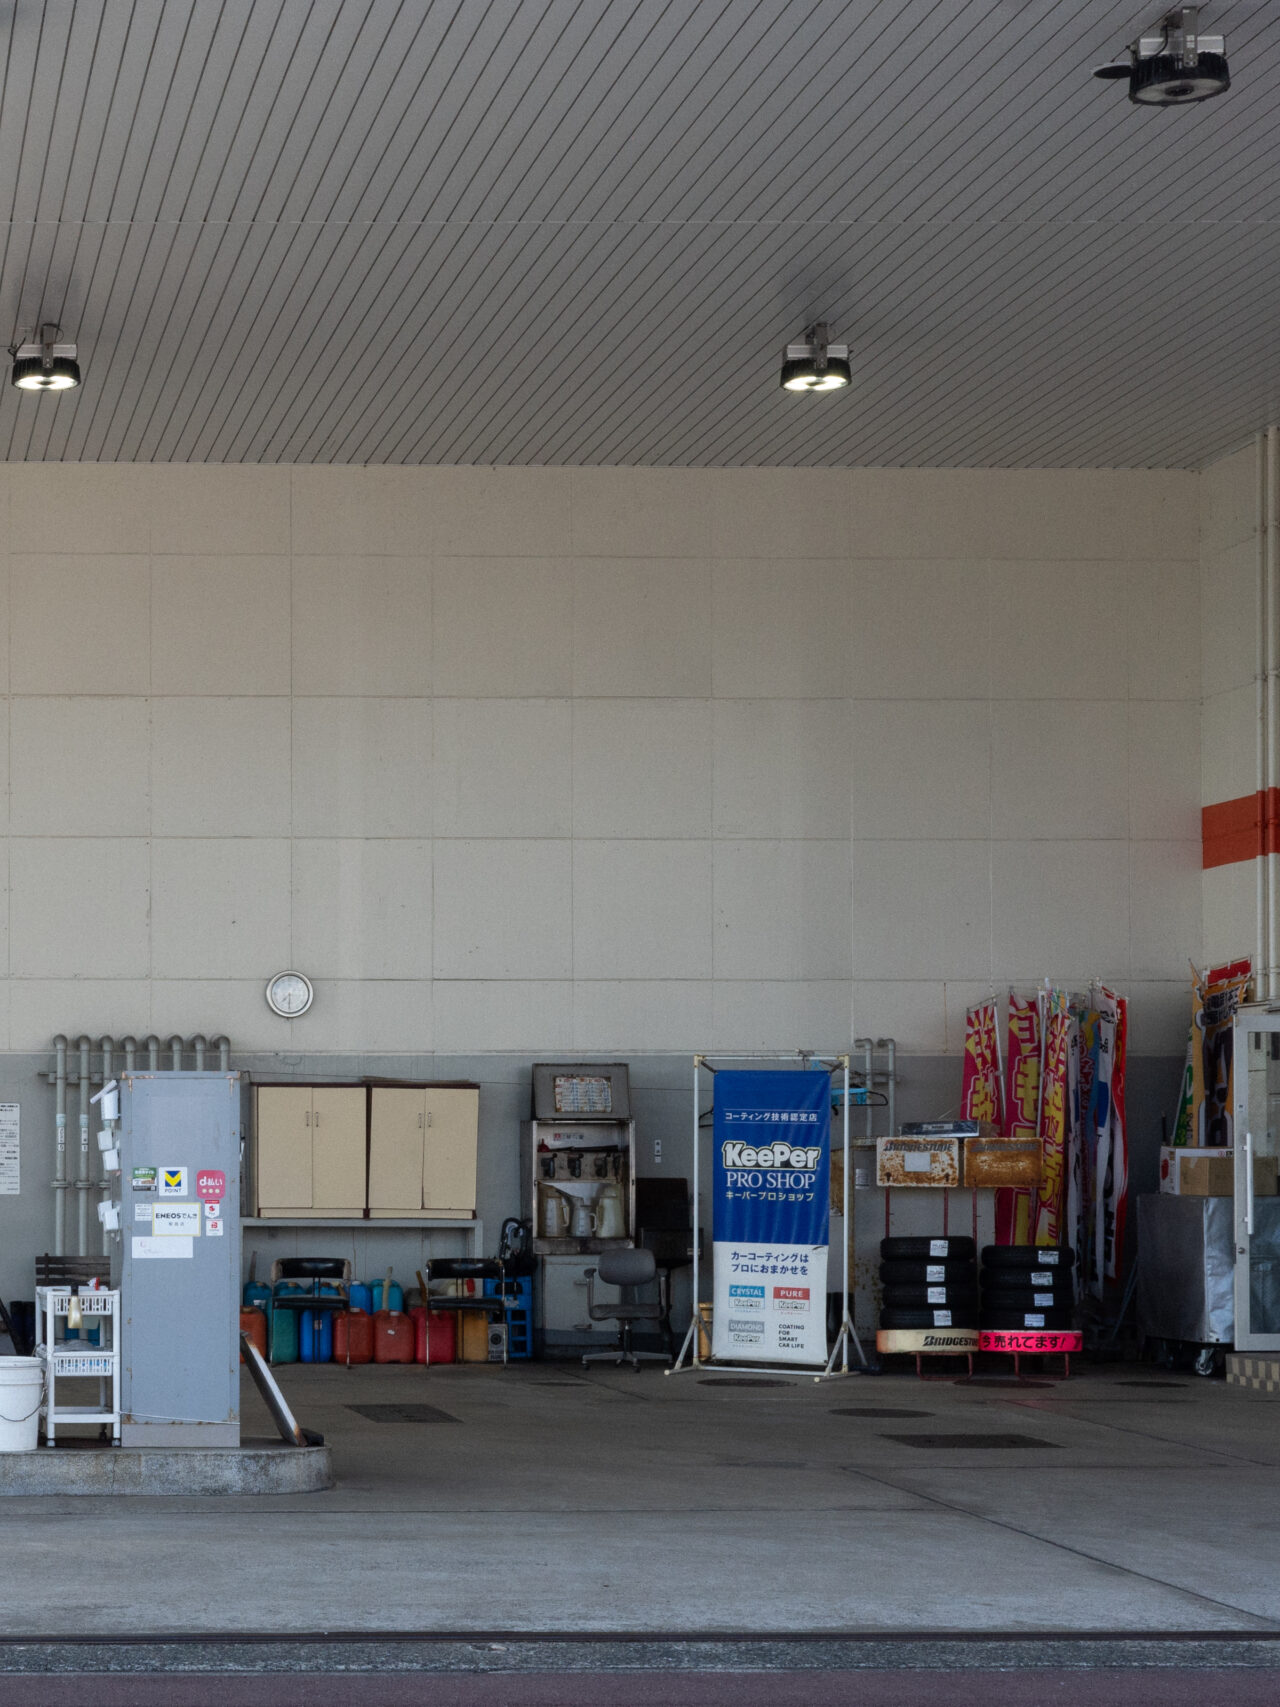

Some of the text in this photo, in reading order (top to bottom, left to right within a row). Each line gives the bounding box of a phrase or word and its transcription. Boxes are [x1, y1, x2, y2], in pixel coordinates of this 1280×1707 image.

[725, 1112, 818, 1122] コーティング技術認定店
[723, 1141, 821, 1169] KeePer
[726, 1172, 816, 1189] PRO SHOP
[725, 1191, 814, 1202] キーパープロショップ
[731, 1251, 809, 1263] カーコーティングは
[731, 1263, 809, 1275] プロにおまかせを
[731, 1288, 763, 1297] CRYSTAL
[780, 1290, 804, 1298] PURE
[730, 1322, 763, 1331] DIAMOND
